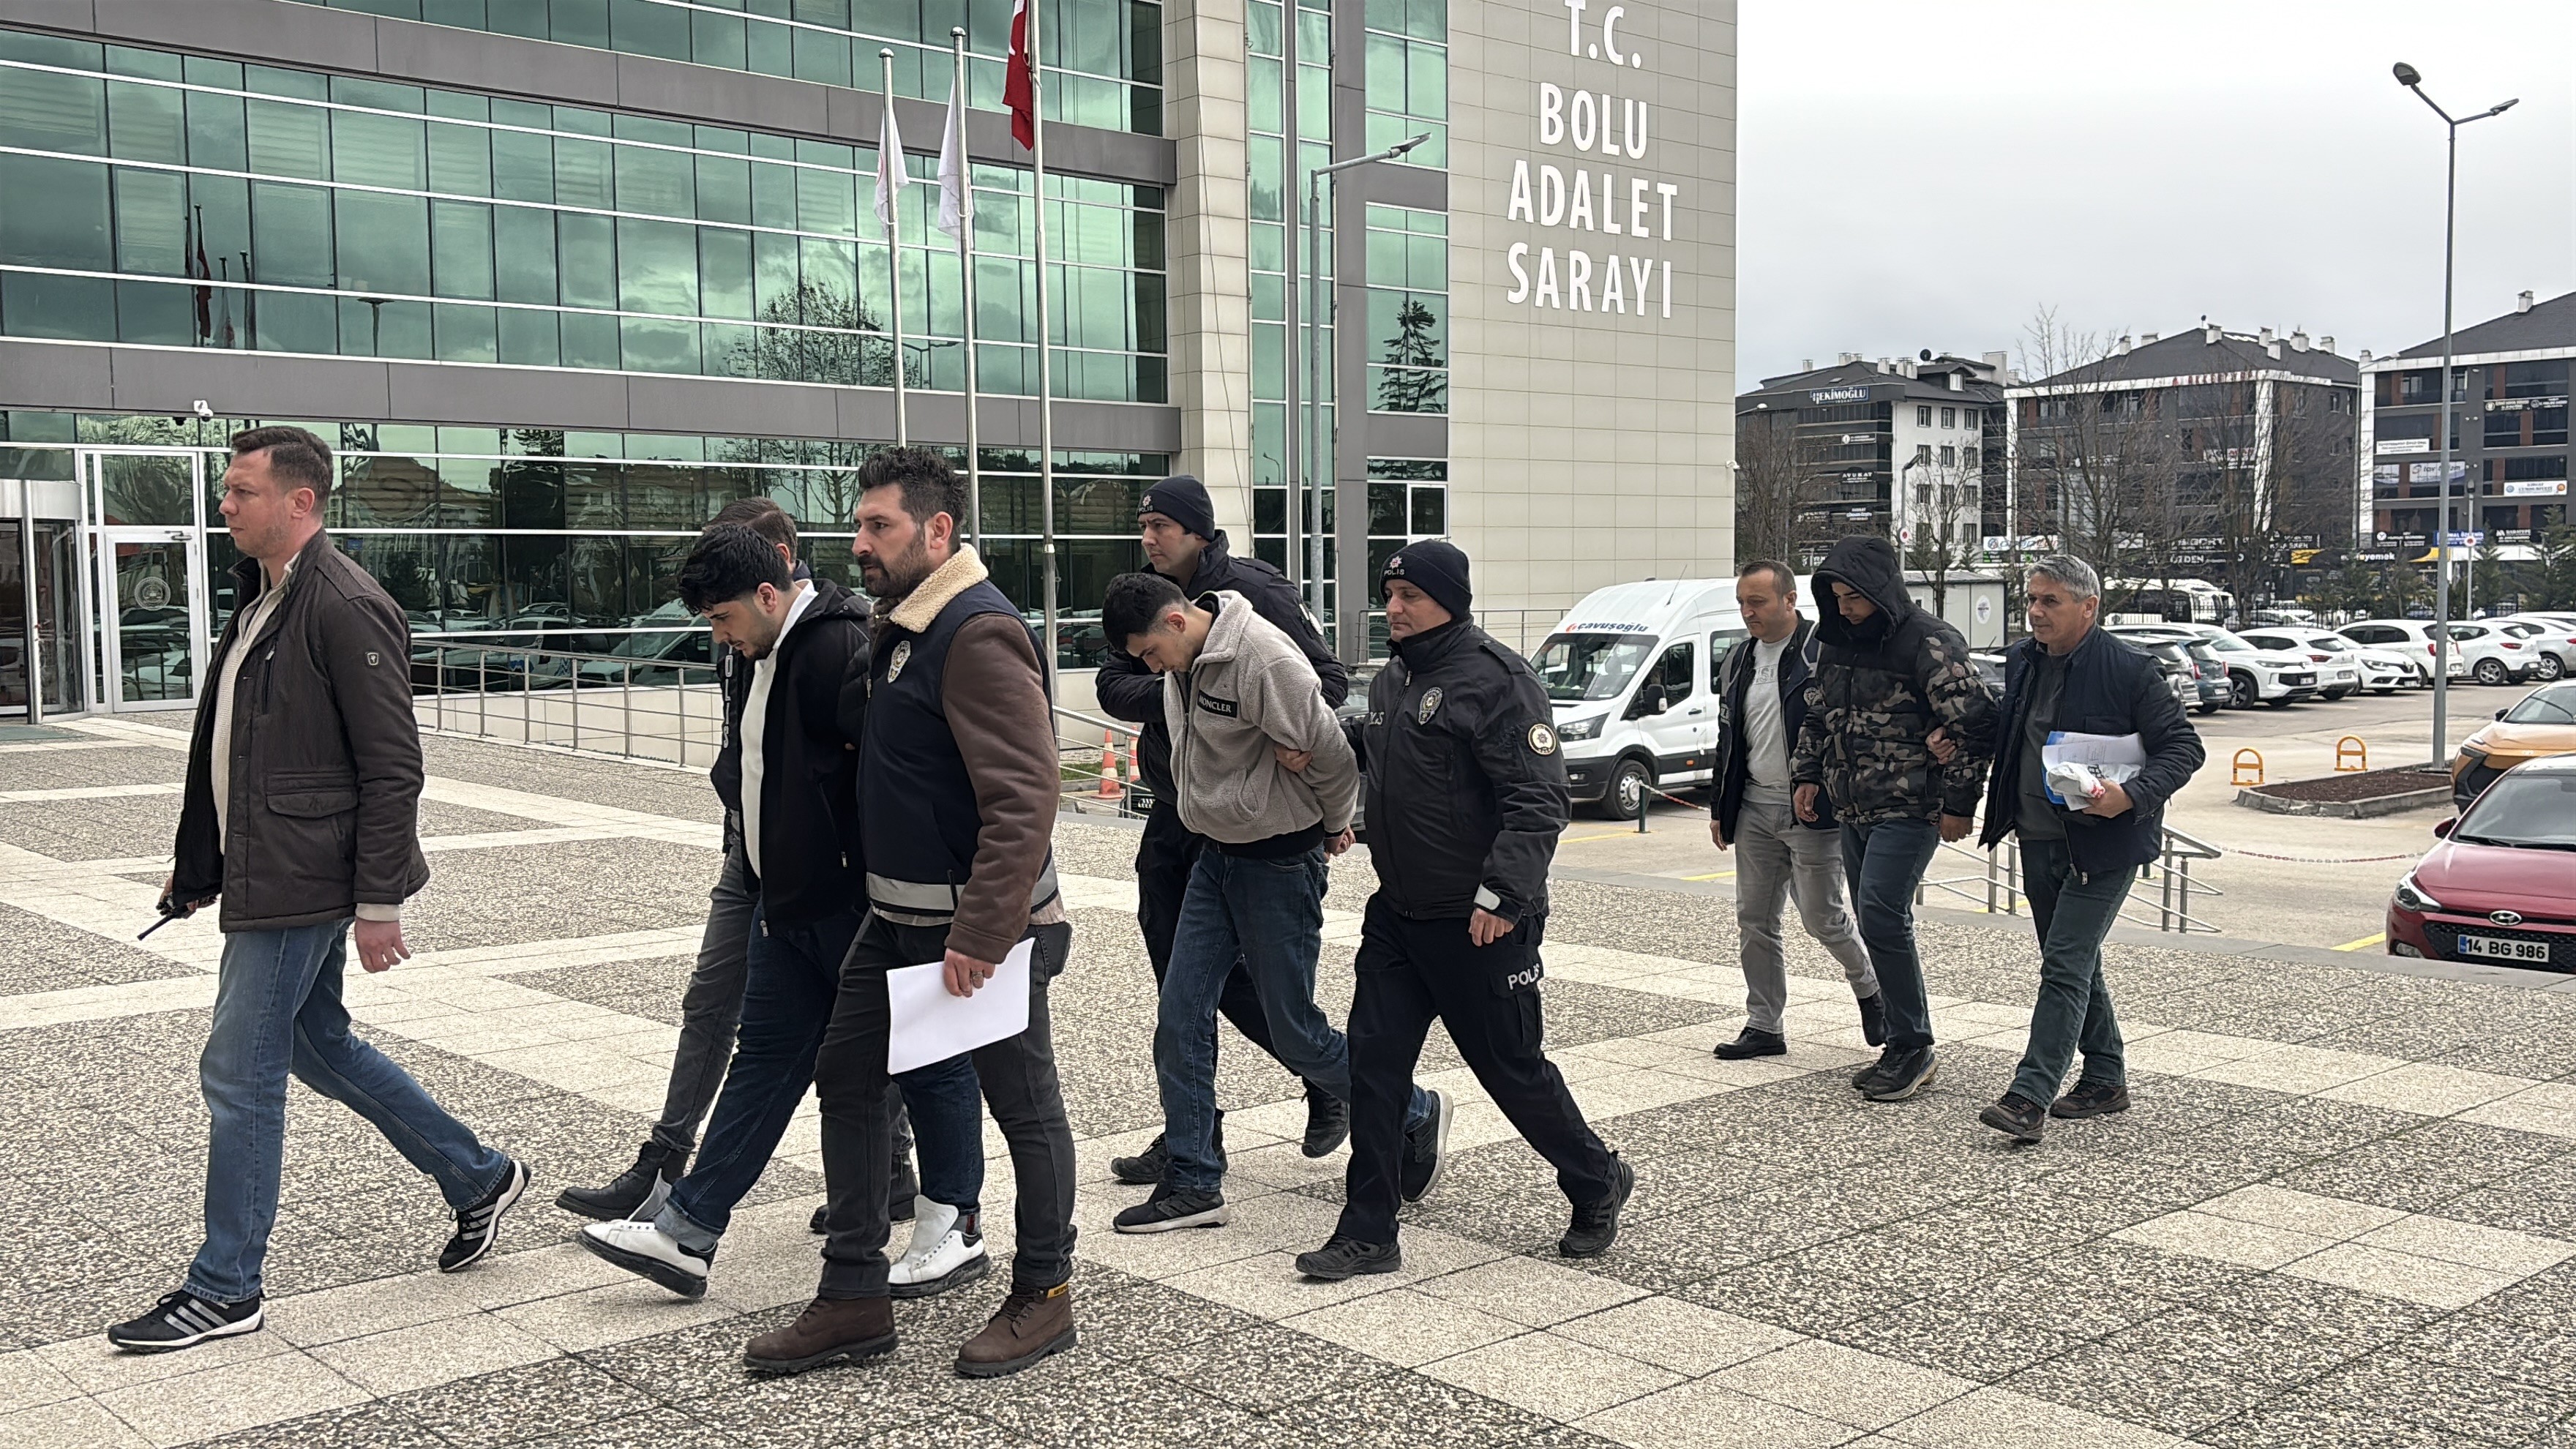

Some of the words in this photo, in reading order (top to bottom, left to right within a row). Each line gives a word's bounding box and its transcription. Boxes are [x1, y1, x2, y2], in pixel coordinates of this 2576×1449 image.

[1565, 0, 1641, 69] T.C.
[1540, 82, 1647, 160] BOLU
[1508, 159, 1677, 242] ADALET
[1507, 242, 1671, 318] SARAYI
[1577, 621, 1649, 632] çavuşoğlu
[1199, 694, 1232, 713] MONCLER
[2466, 938, 2482, 953] 14
[2488, 941, 2512, 956] BG
[2516, 944, 2546, 959] 986
